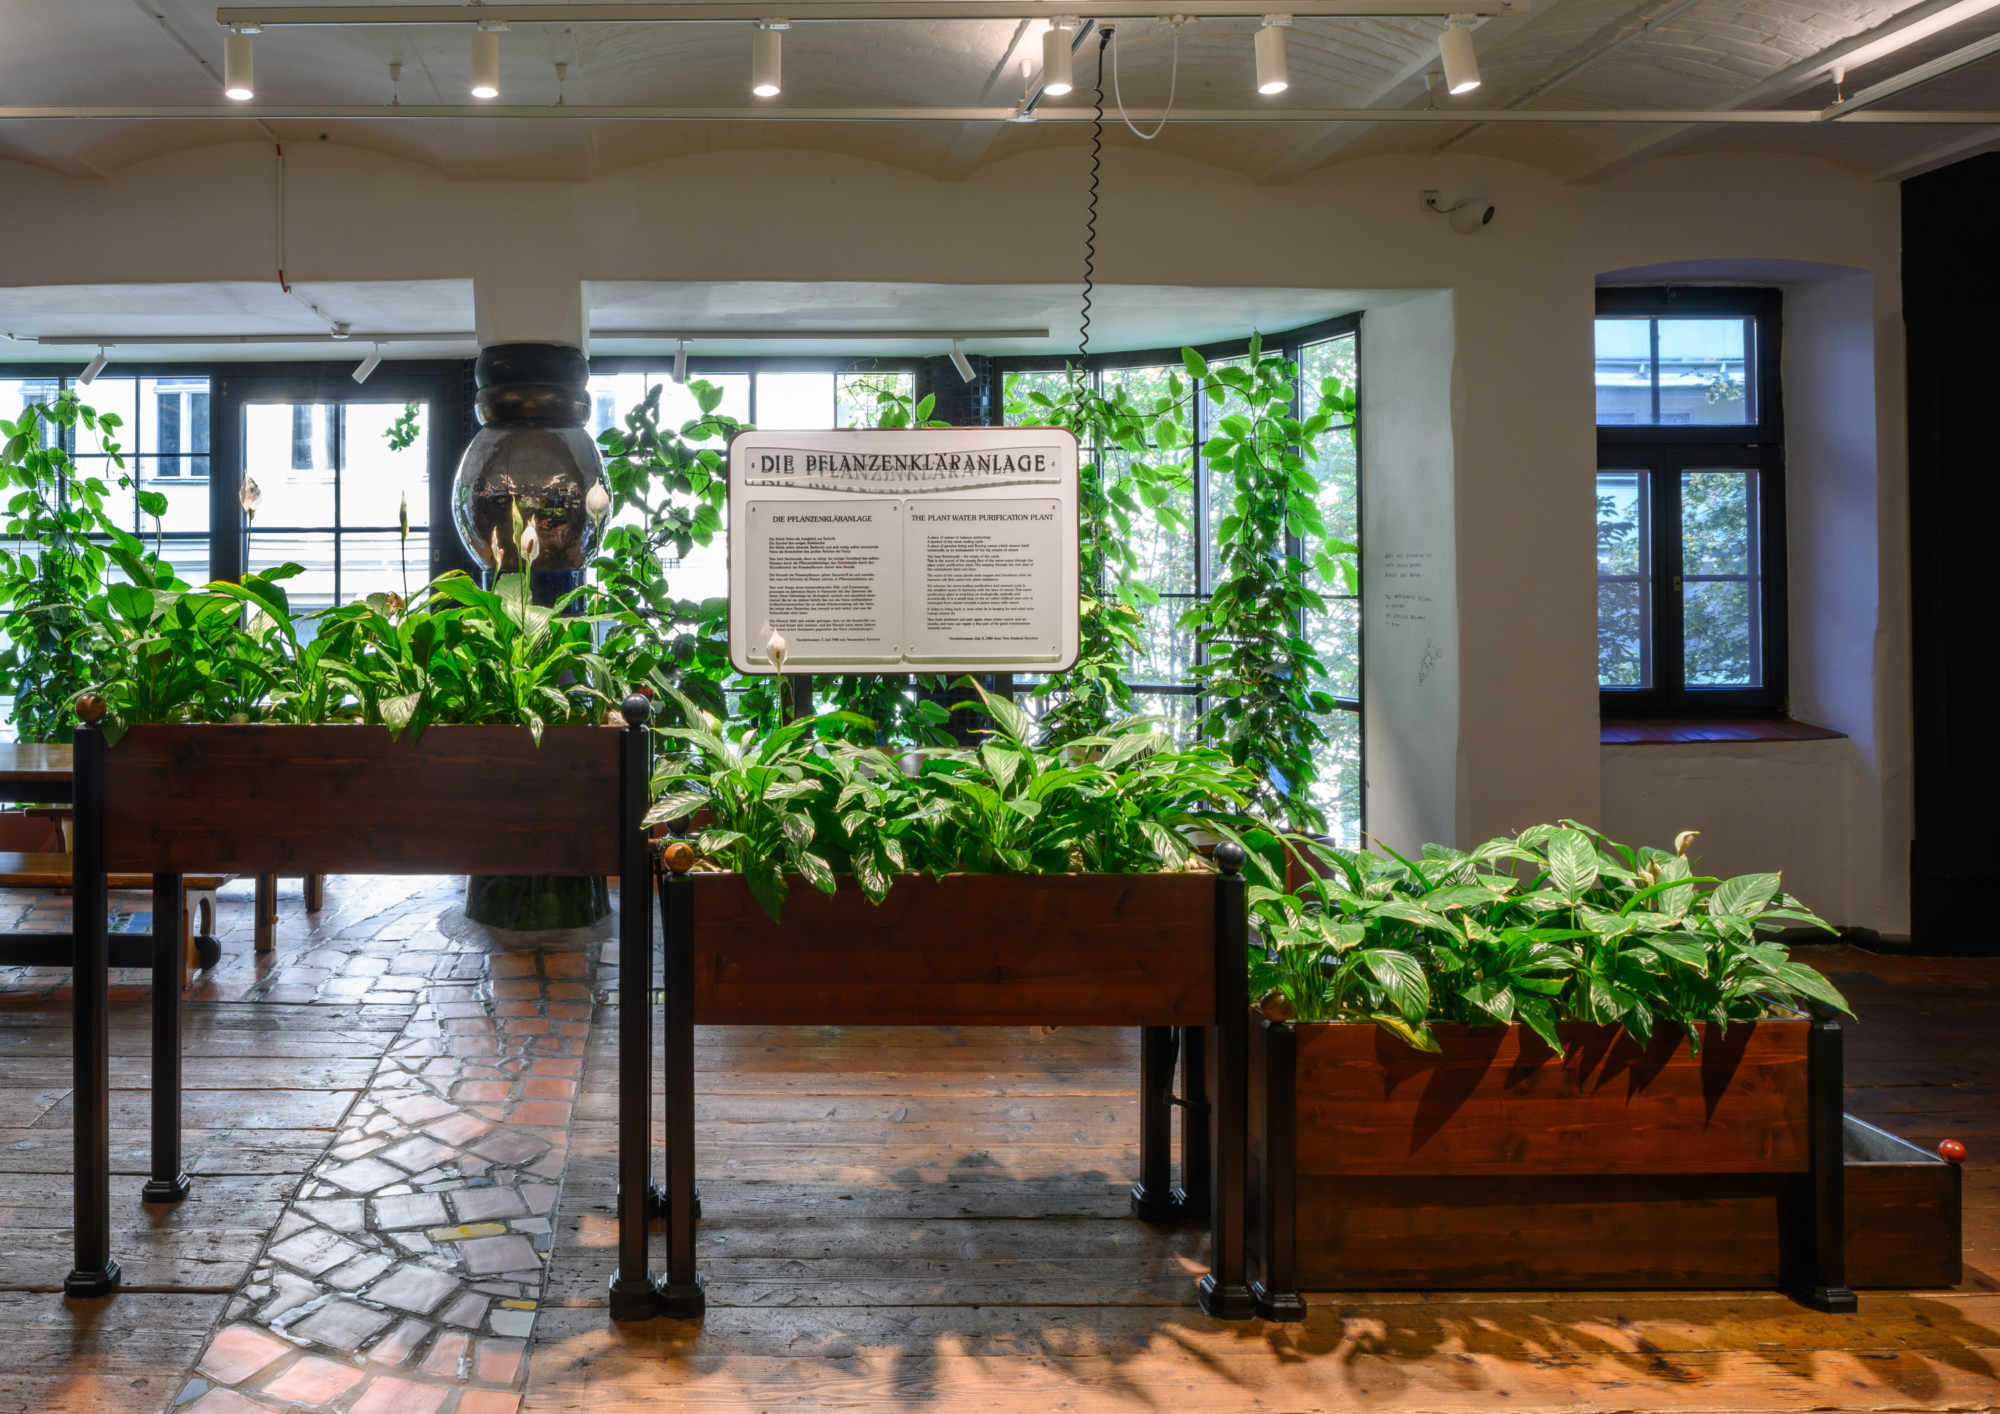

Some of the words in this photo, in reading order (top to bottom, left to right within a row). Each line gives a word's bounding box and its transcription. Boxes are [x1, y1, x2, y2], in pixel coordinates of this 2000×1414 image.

[761, 455, 794, 473] DIE
[806, 453, 1046, 472] PFLANZENKLÄRANLAGE
[787, 515, 873, 523] PFLANZENKLÄRANLAGE
